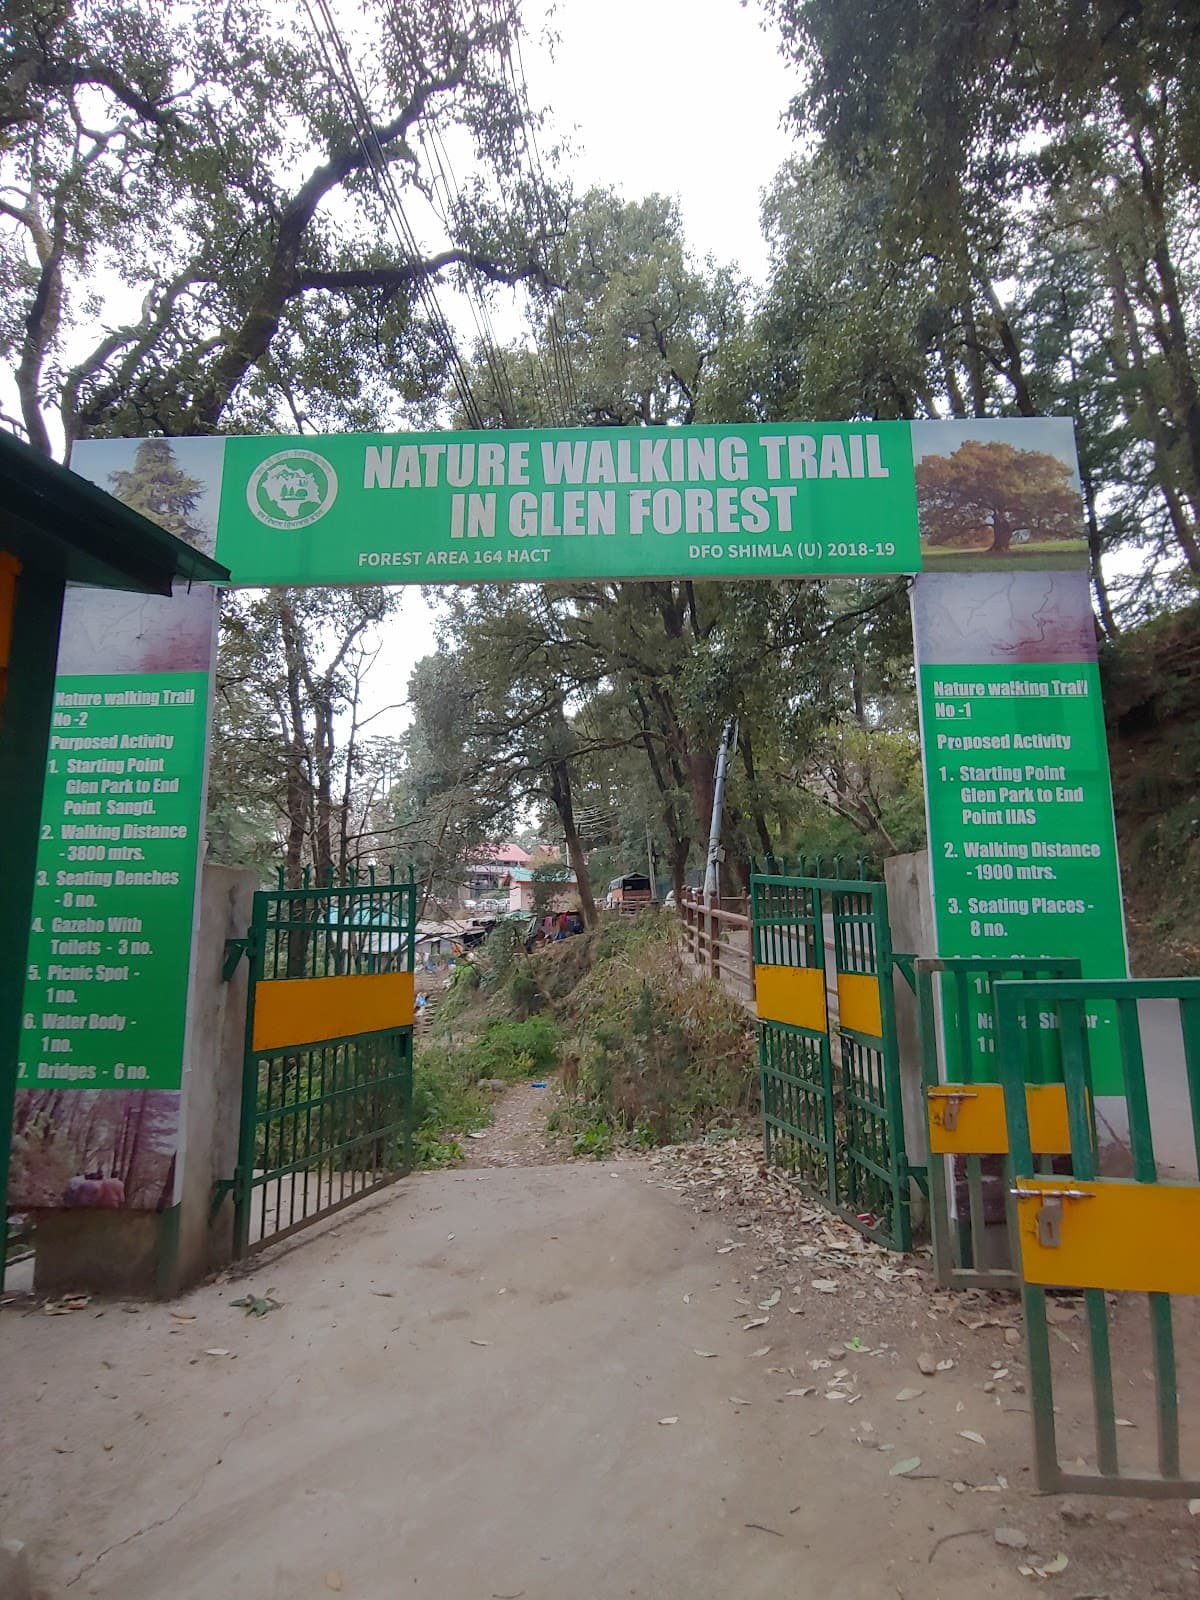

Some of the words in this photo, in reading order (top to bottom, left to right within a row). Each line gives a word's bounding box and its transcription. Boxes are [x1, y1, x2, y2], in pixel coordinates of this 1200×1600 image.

[363, 442, 530, 489] NATURE
[541, 436, 749, 485] WALKING
[759, 434, 890, 480] TRAIL
[450, 493, 497, 539] IN
[509, 490, 616, 537] GLEN
[629, 486, 798, 535] FOREST
[358, 552, 423, 567] FOREST
[426, 551, 469, 565] AREA
[473, 550, 502, 564] 164
[507, 549, 551, 563] HACT
[689, 545, 723, 559] DFO
[727, 543, 793, 558] SHIMLA
[797, 542, 823, 560] (U)
[828, 542, 895, 557] 2018-19
[933, 680, 985, 698] Nature
[988, 680, 1049, 698] walking
[1051, 679, 1088, 697] Trail
[55, 691, 103, 708] Nature
[104, 690, 160, 707] walking
[163, 688, 195, 706] Trail
[935, 702, 955, 719] No
[53, 712, 72, 728] No
[50, 734, 118, 750] Purposed
[120, 733, 174, 750] Activity
[937, 733, 1010, 750] Proposed
[1013, 733, 1071, 750] Activity
[48, 759, 58, 773] 1.
[67, 758, 124, 774] Starting
[127, 757, 164, 773] Point
[959, 765, 1022, 782] Starting
[1025, 765, 1066, 781] Point
[66, 779, 99, 794] Glen
[101, 779, 133, 794] Park
[136, 779, 150, 794] to
[153, 778, 179, 793] End
[960, 787, 996, 803] Glen
[999, 787, 1034, 803] Park
[1036, 787, 1053, 803] to
[1055, 787, 1083, 802] End
[64, 800, 101, 815] Point
[962, 809, 1003, 825] Point
[41, 825, 53, 840] 2.
[61, 825, 120, 841] Walking
[123, 824, 187, 839] Distance
[107, 846, 145, 860] mtrs.
[944, 842, 958, 858] 2.
[963, 842, 1029, 860] Walking
[1031, 841, 1101, 858] Distance
[36, 871, 49, 886] 3.
[56, 870, 113, 887] Seating
[115, 870, 180, 886] Benches
[975, 863, 1014, 880] 1900
[1016, 865, 1057, 880] mtrs.
[75, 894, 98, 907] no.
[948, 897, 962, 914] 3.
[968, 897, 1029, 915] Seating
[1031, 897, 1085, 914] Places
[31, 917, 44, 933] 4.
[52, 917, 105, 933] Gazebo
[108, 916, 142, 932] With
[970, 920, 981, 937] 8
[983, 922, 1008, 937] no.
[50, 939, 101, 955] Toilets
[118, 939, 128, 954] 3
[130, 941, 153, 955] no.
[28, 965, 41, 981] 5.
[47, 965, 93, 981] Picnic
[95, 965, 129, 982] Spot
[46, 987, 54, 1003] 1
[55, 989, 78, 1003] no.
[23, 1013, 37, 1029] 6.
[42, 1013, 87, 1029] Water
[88, 1013, 126, 1031] Body
[41, 1036, 49, 1052] 1
[51, 1038, 73, 1052] no.
[37, 1062, 96, 1080] Bridges
[114, 1063, 124, 1079] 6
[127, 1065, 150, 1079] no.
